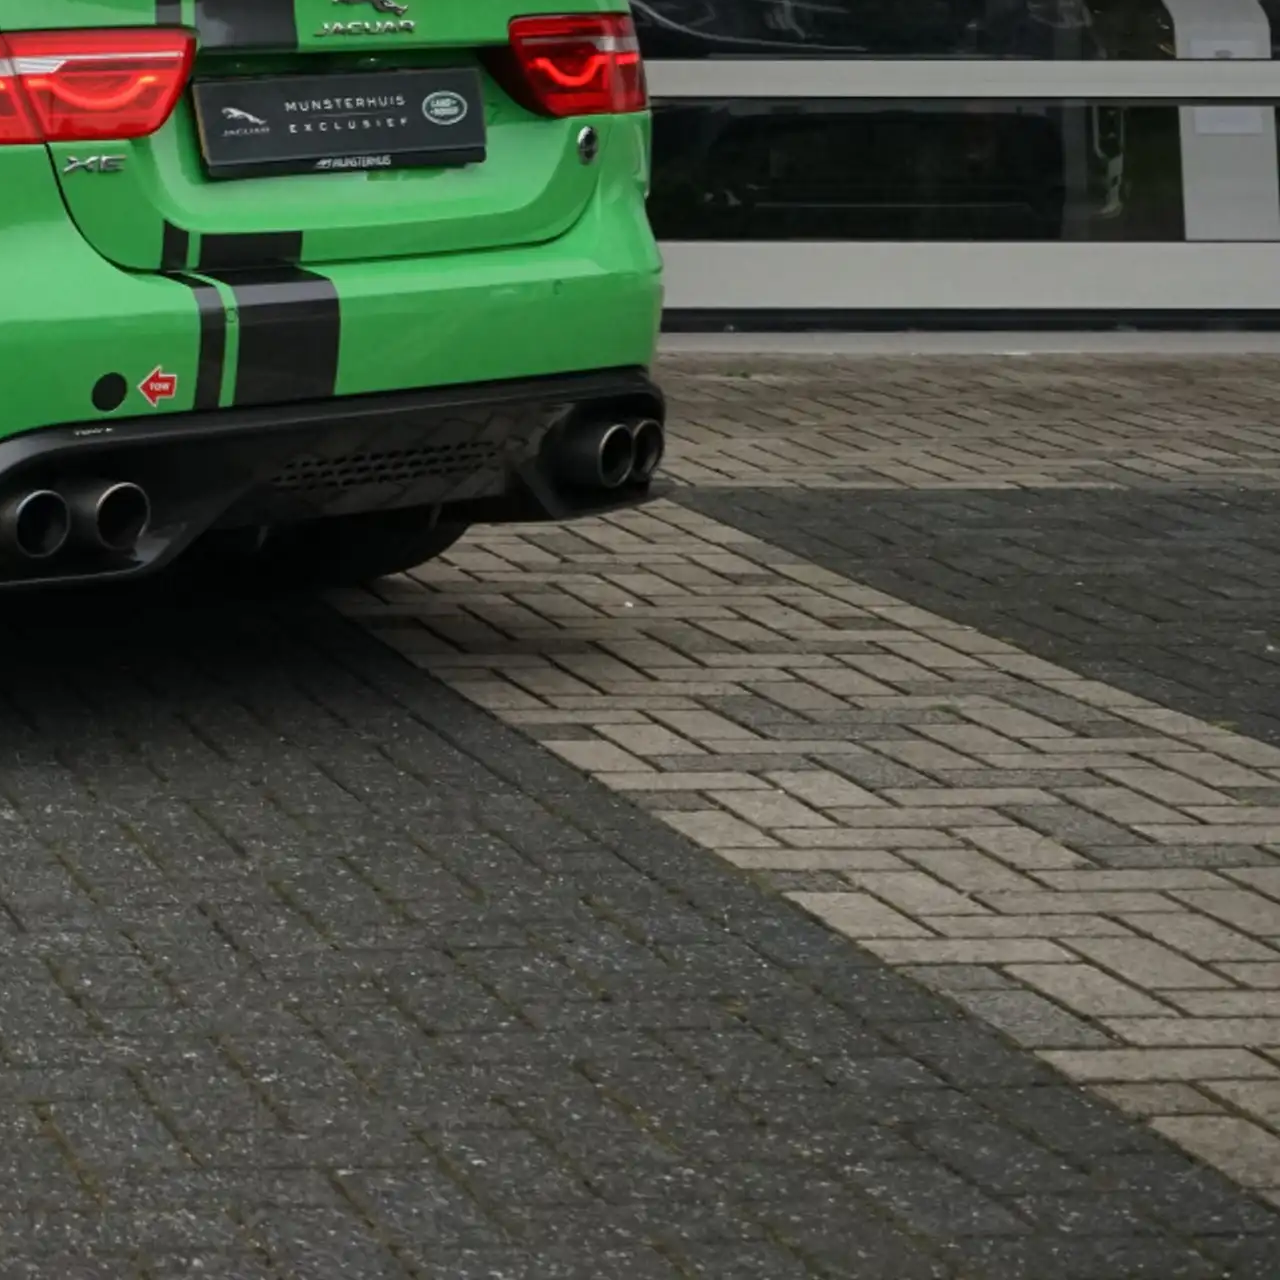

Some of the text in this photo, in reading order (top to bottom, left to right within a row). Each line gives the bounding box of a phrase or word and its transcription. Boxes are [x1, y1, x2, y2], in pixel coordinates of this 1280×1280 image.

[313, 19, 416, 38] JAGUAR
[283, 95, 407, 113] MUNSTERHUIS
[287, 117, 409, 135] EXCLUSIEF
[63, 153, 128, 174] XE
